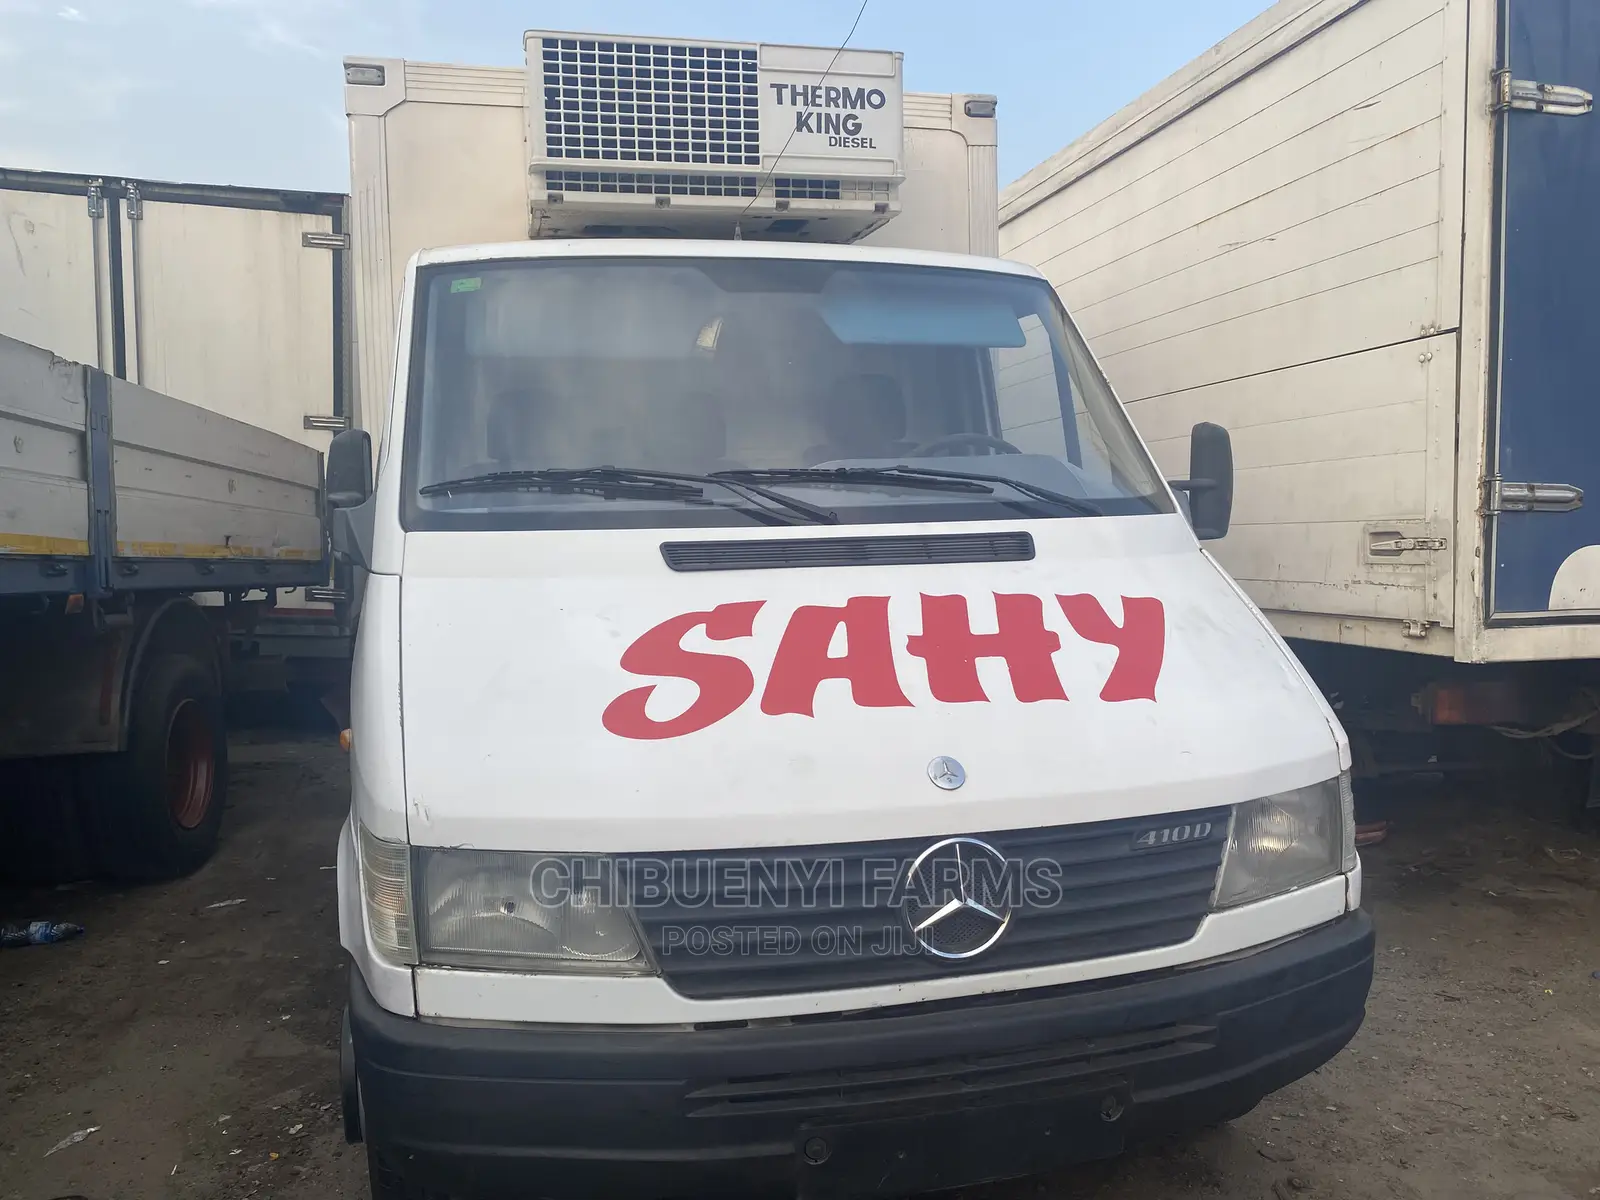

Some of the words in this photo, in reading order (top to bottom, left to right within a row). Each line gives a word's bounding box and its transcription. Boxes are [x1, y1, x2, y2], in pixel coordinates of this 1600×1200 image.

[769, 83, 886, 110] THERMO
[796, 111, 862, 135] KING
[828, 136, 877, 149] DIESEL
[602, 591, 1165, 740] SAHY
